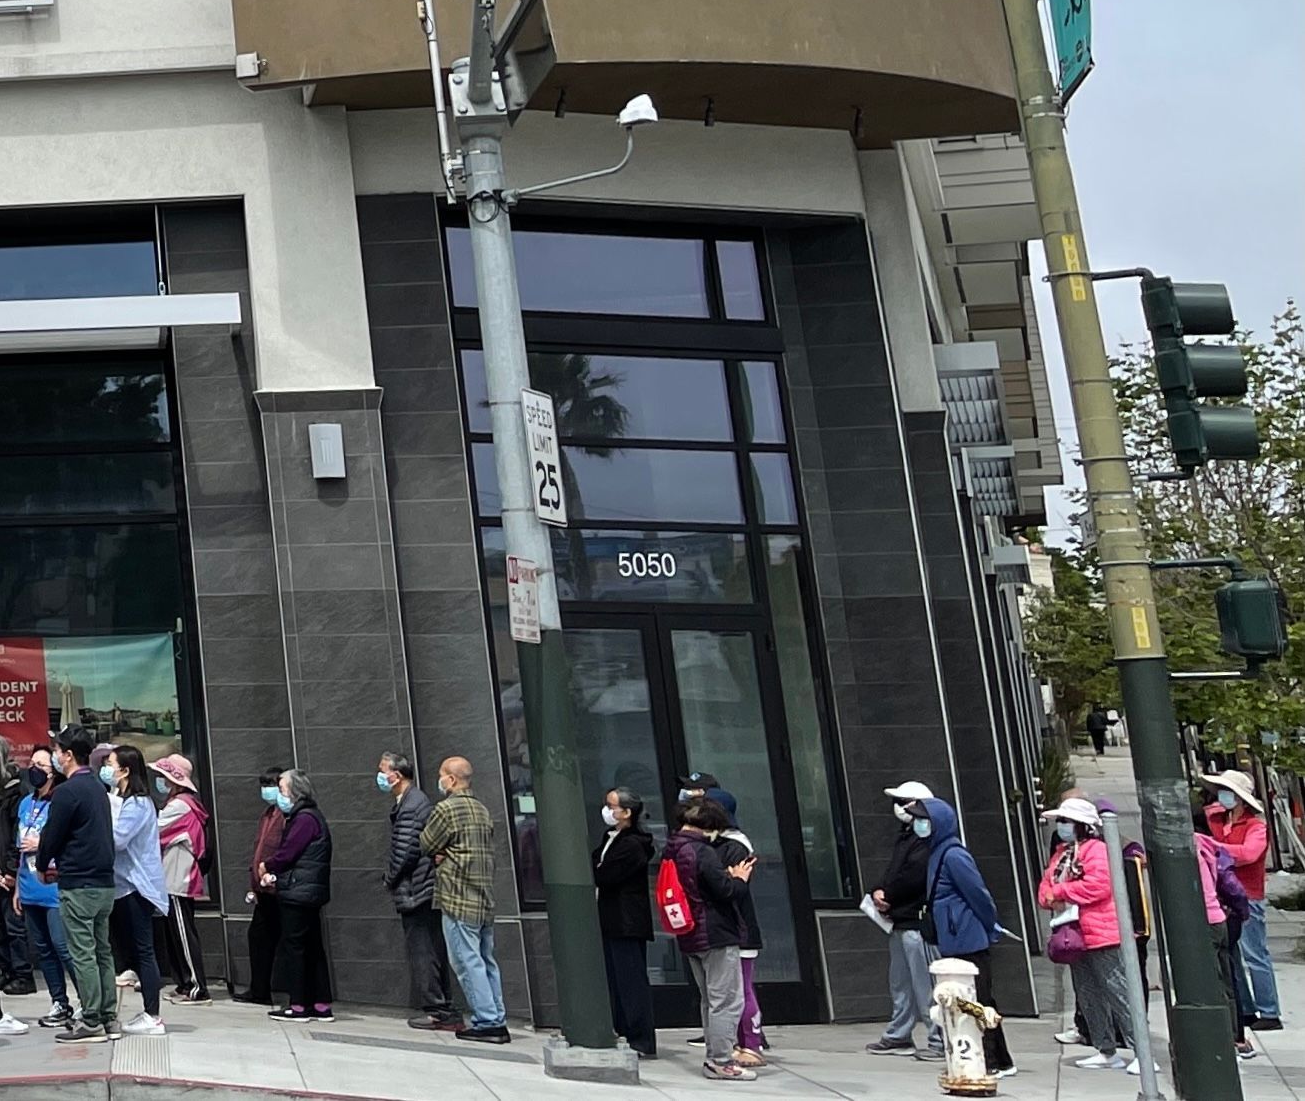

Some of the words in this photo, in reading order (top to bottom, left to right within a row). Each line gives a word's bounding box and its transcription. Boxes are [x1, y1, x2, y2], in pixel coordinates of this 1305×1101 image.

[525, 403, 553, 429] SPEED
[531, 431, 553, 455] LIMIT
[535, 459, 561, 510] 25
[618, 552, 677, 577] 5050
[957, 1038, 973, 1061] 2
